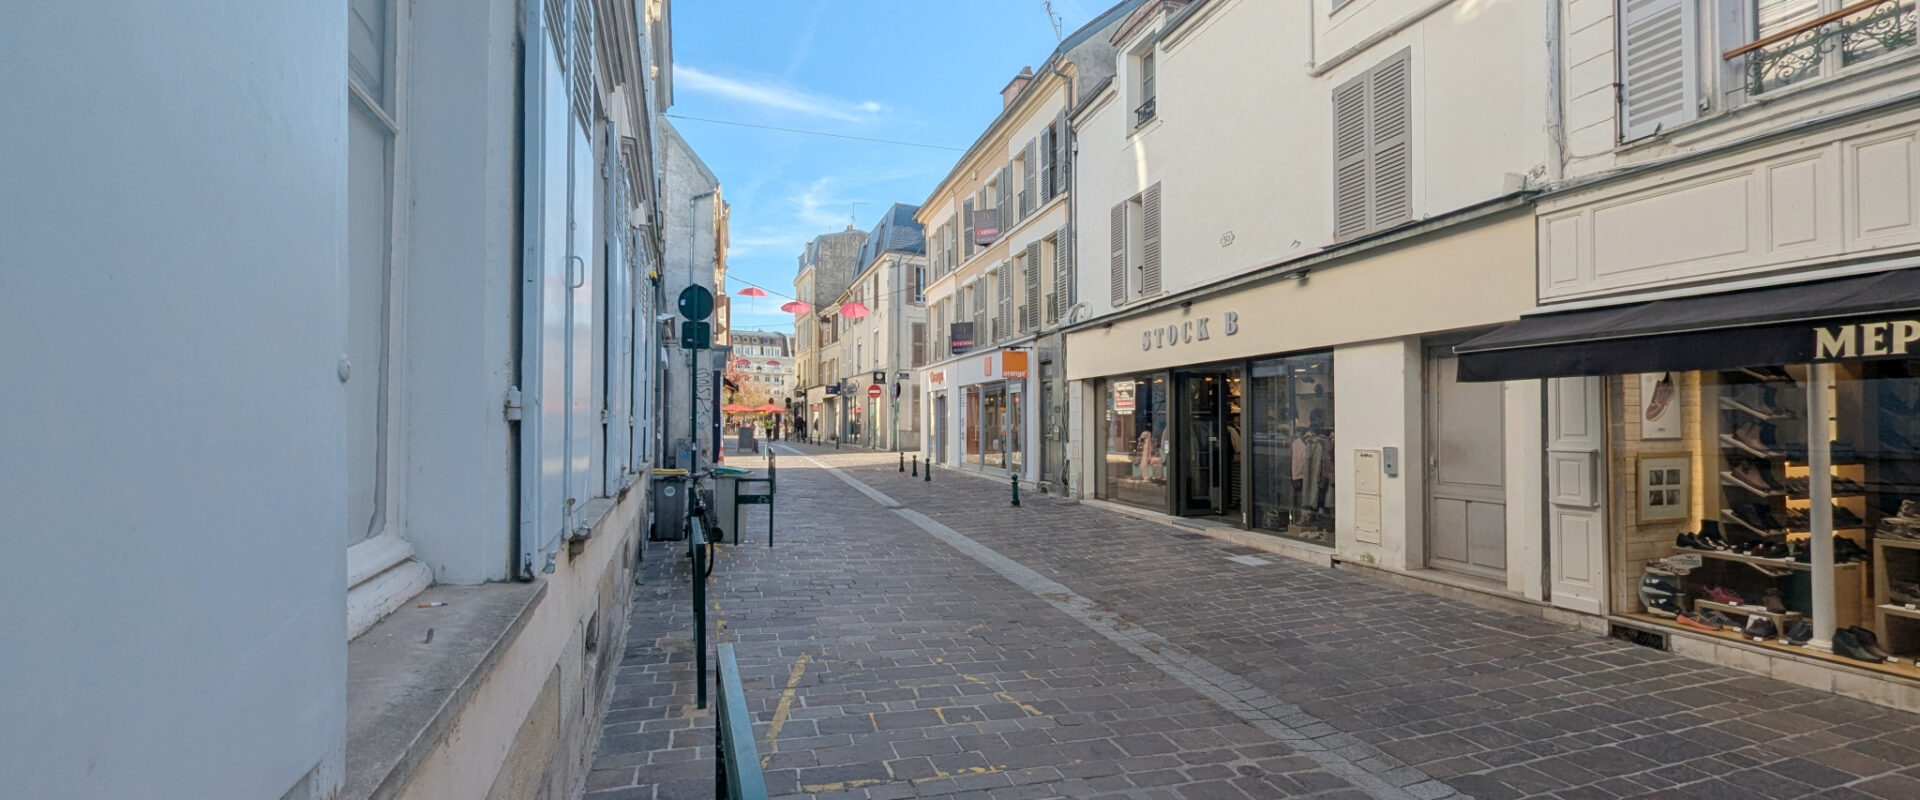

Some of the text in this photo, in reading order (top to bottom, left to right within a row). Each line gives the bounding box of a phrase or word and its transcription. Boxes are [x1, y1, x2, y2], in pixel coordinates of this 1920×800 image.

[1142, 311, 1238, 351] STOCK B
[1812, 320, 1920, 359] MEP
[1003, 370, 1025, 378] orange
